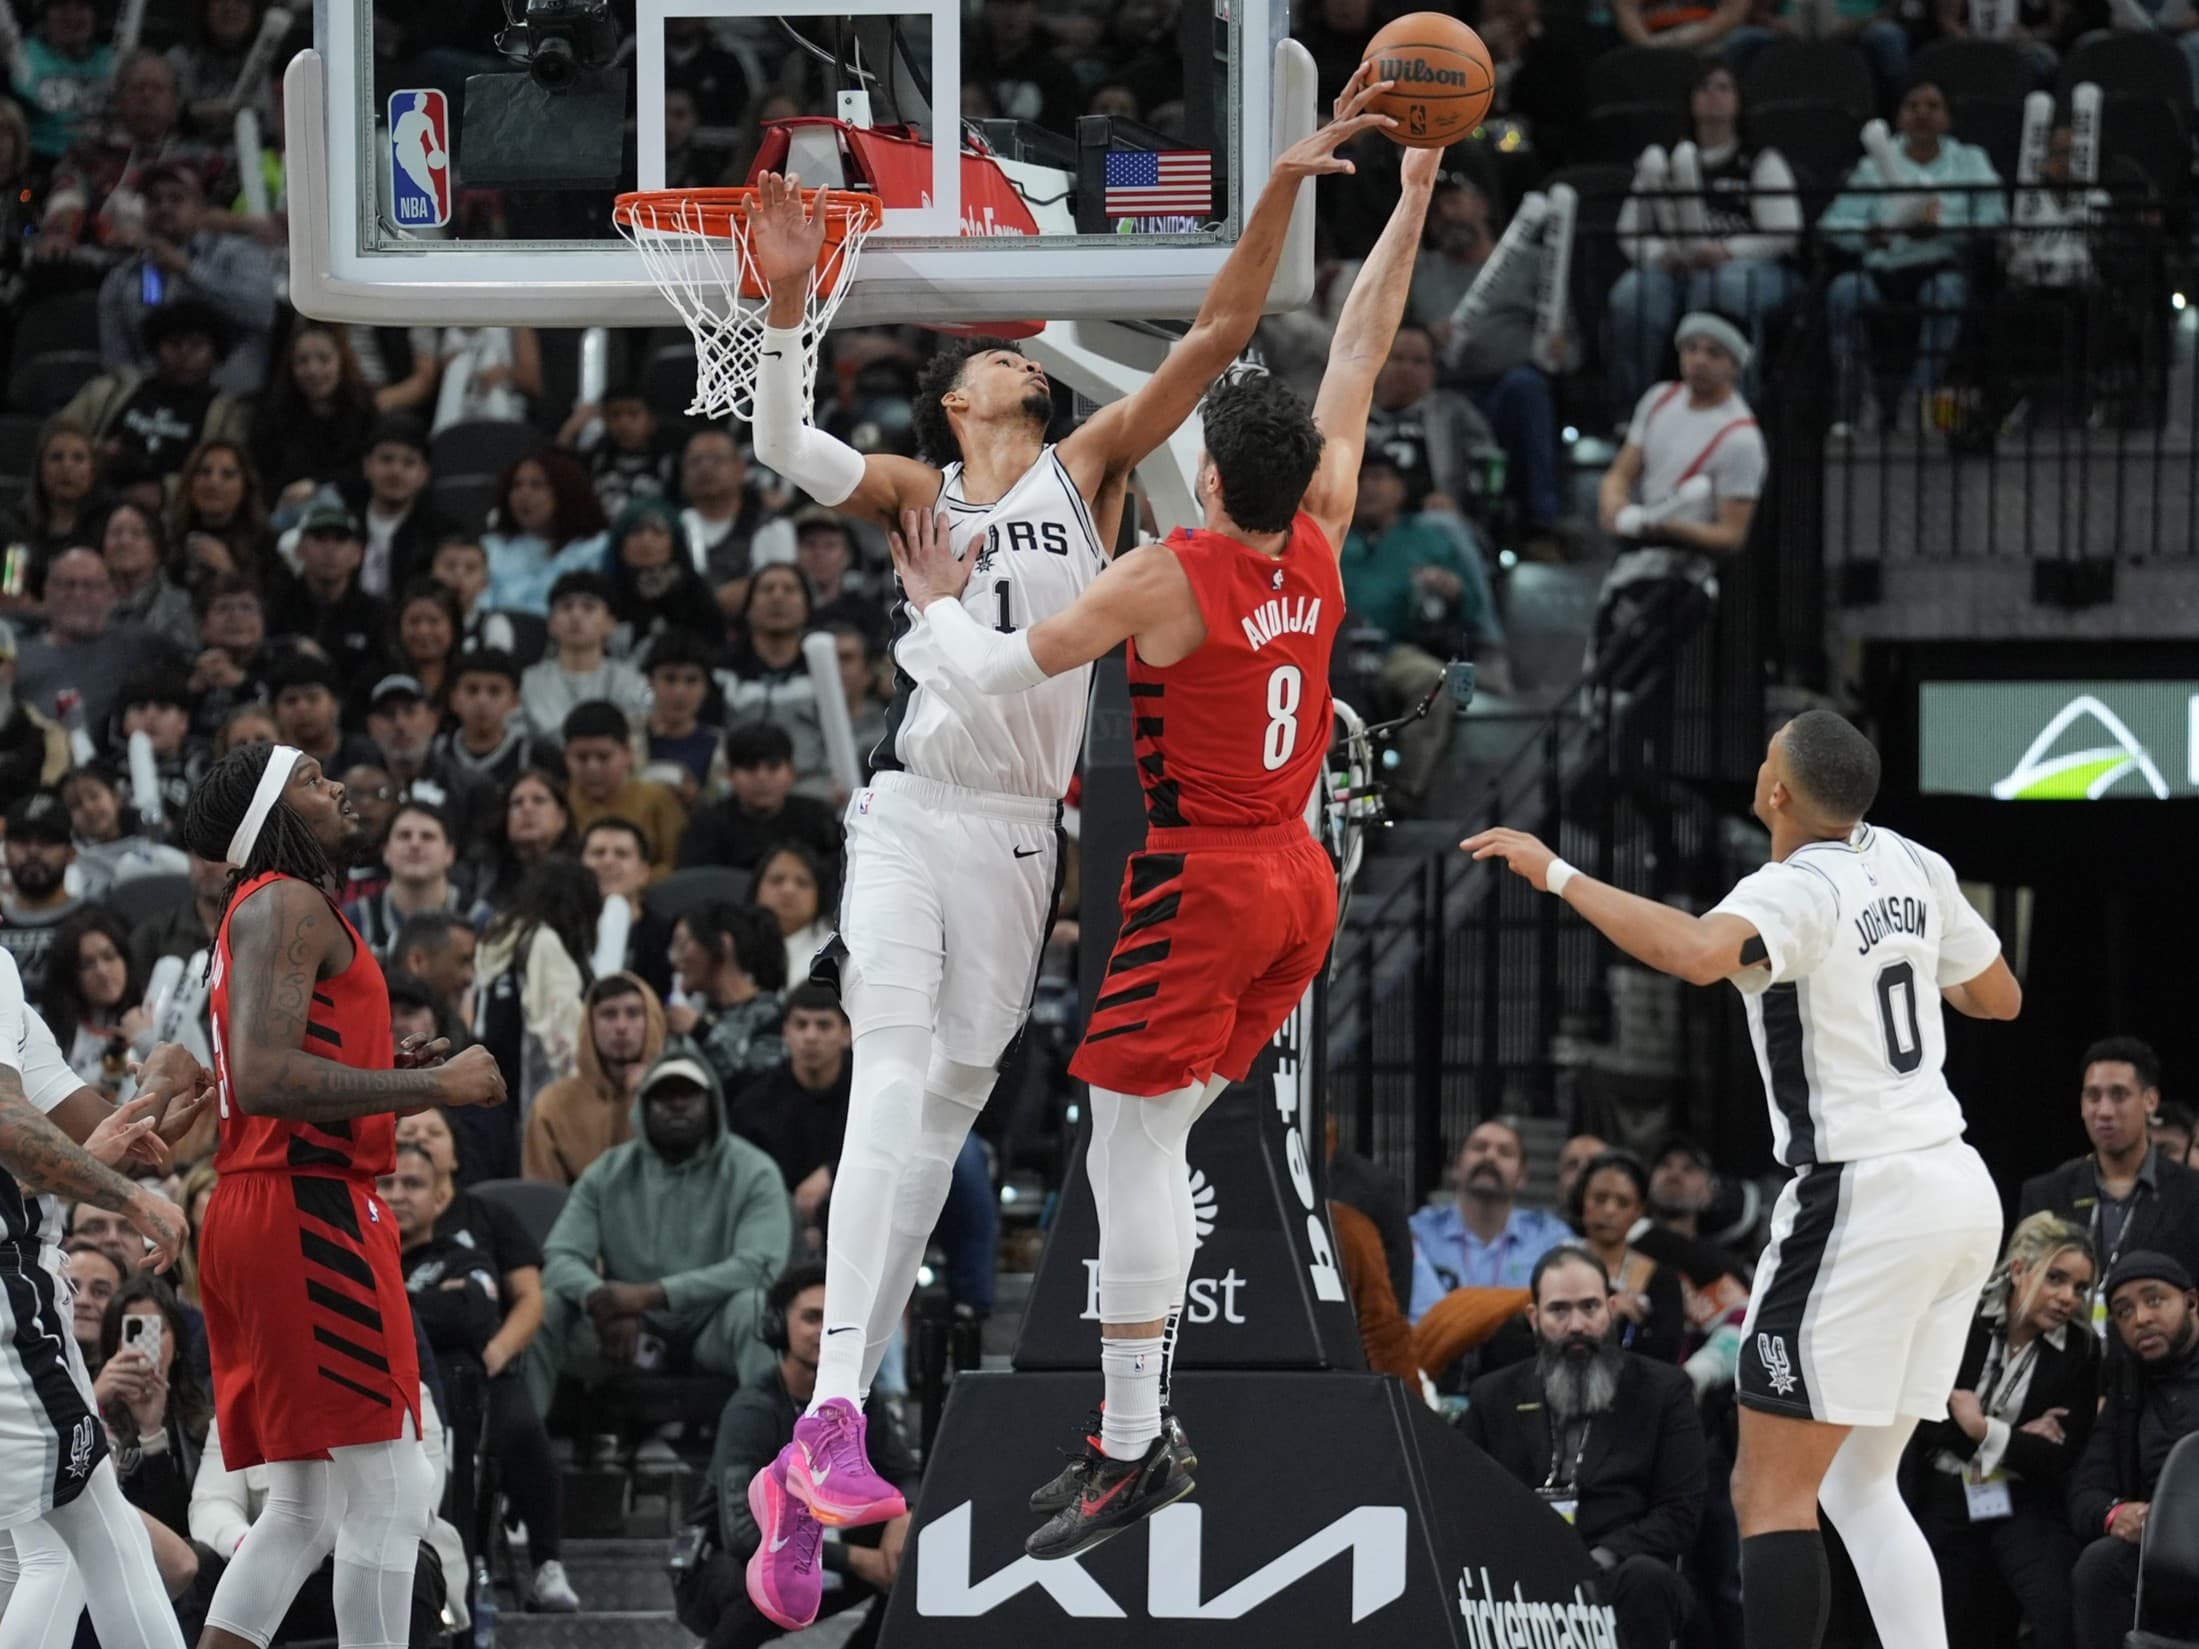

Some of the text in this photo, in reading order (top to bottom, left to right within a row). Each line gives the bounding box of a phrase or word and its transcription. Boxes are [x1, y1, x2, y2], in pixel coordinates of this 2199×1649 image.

[1379, 57, 1467, 88] Wilson
[400, 196, 429, 219] NBA
[993, 578, 1018, 634] 1
[1241, 596, 1321, 652] AVDIJA
[1262, 664, 1302, 771] 8
[1854, 896, 1927, 956] JOHNSON
[1874, 957, 1925, 1077] 0
